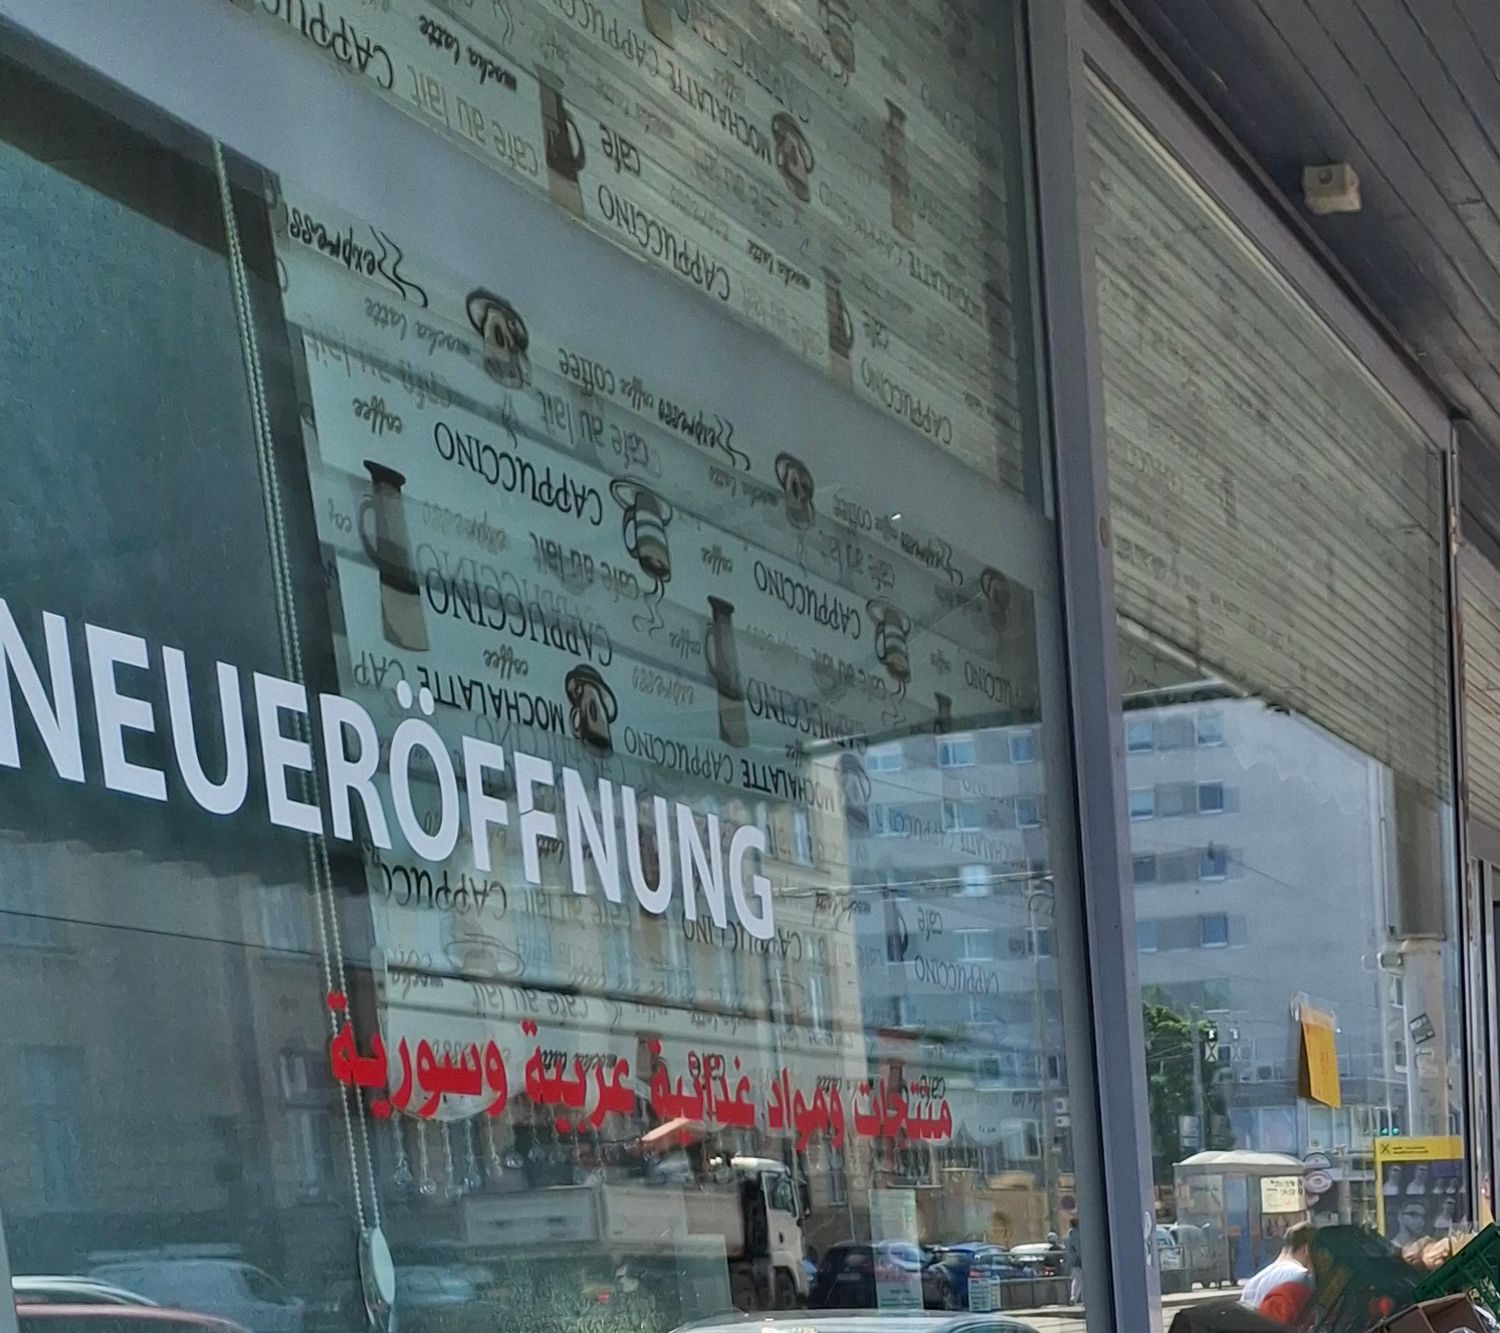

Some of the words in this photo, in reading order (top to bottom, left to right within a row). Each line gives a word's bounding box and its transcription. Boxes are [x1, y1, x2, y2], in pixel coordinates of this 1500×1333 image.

[598, 183, 731, 302] CAPPUCCINO
[558, 347, 614, 397] coffee
[351, 397, 403, 438] coffee
[433, 421, 603, 527] CAPPUCCINO
[423, 568, 612, 666] CAPPUCCINO
[752, 560, 861, 639] CAPPUCCINO
[482, 644, 528, 679] coffee
[0, 597, 775, 941] NEUERÖFFNUNG
[623, 726, 734, 783] CAPPUCCINO
[914, 954, 999, 993] CAPPUCCINO
[328, 990, 510, 1119] وسورية
[525, 1020, 636, 1135] عربية
[767, 1064, 845, 1150] ومواد
[853, 1072, 953, 1143] منتجات
